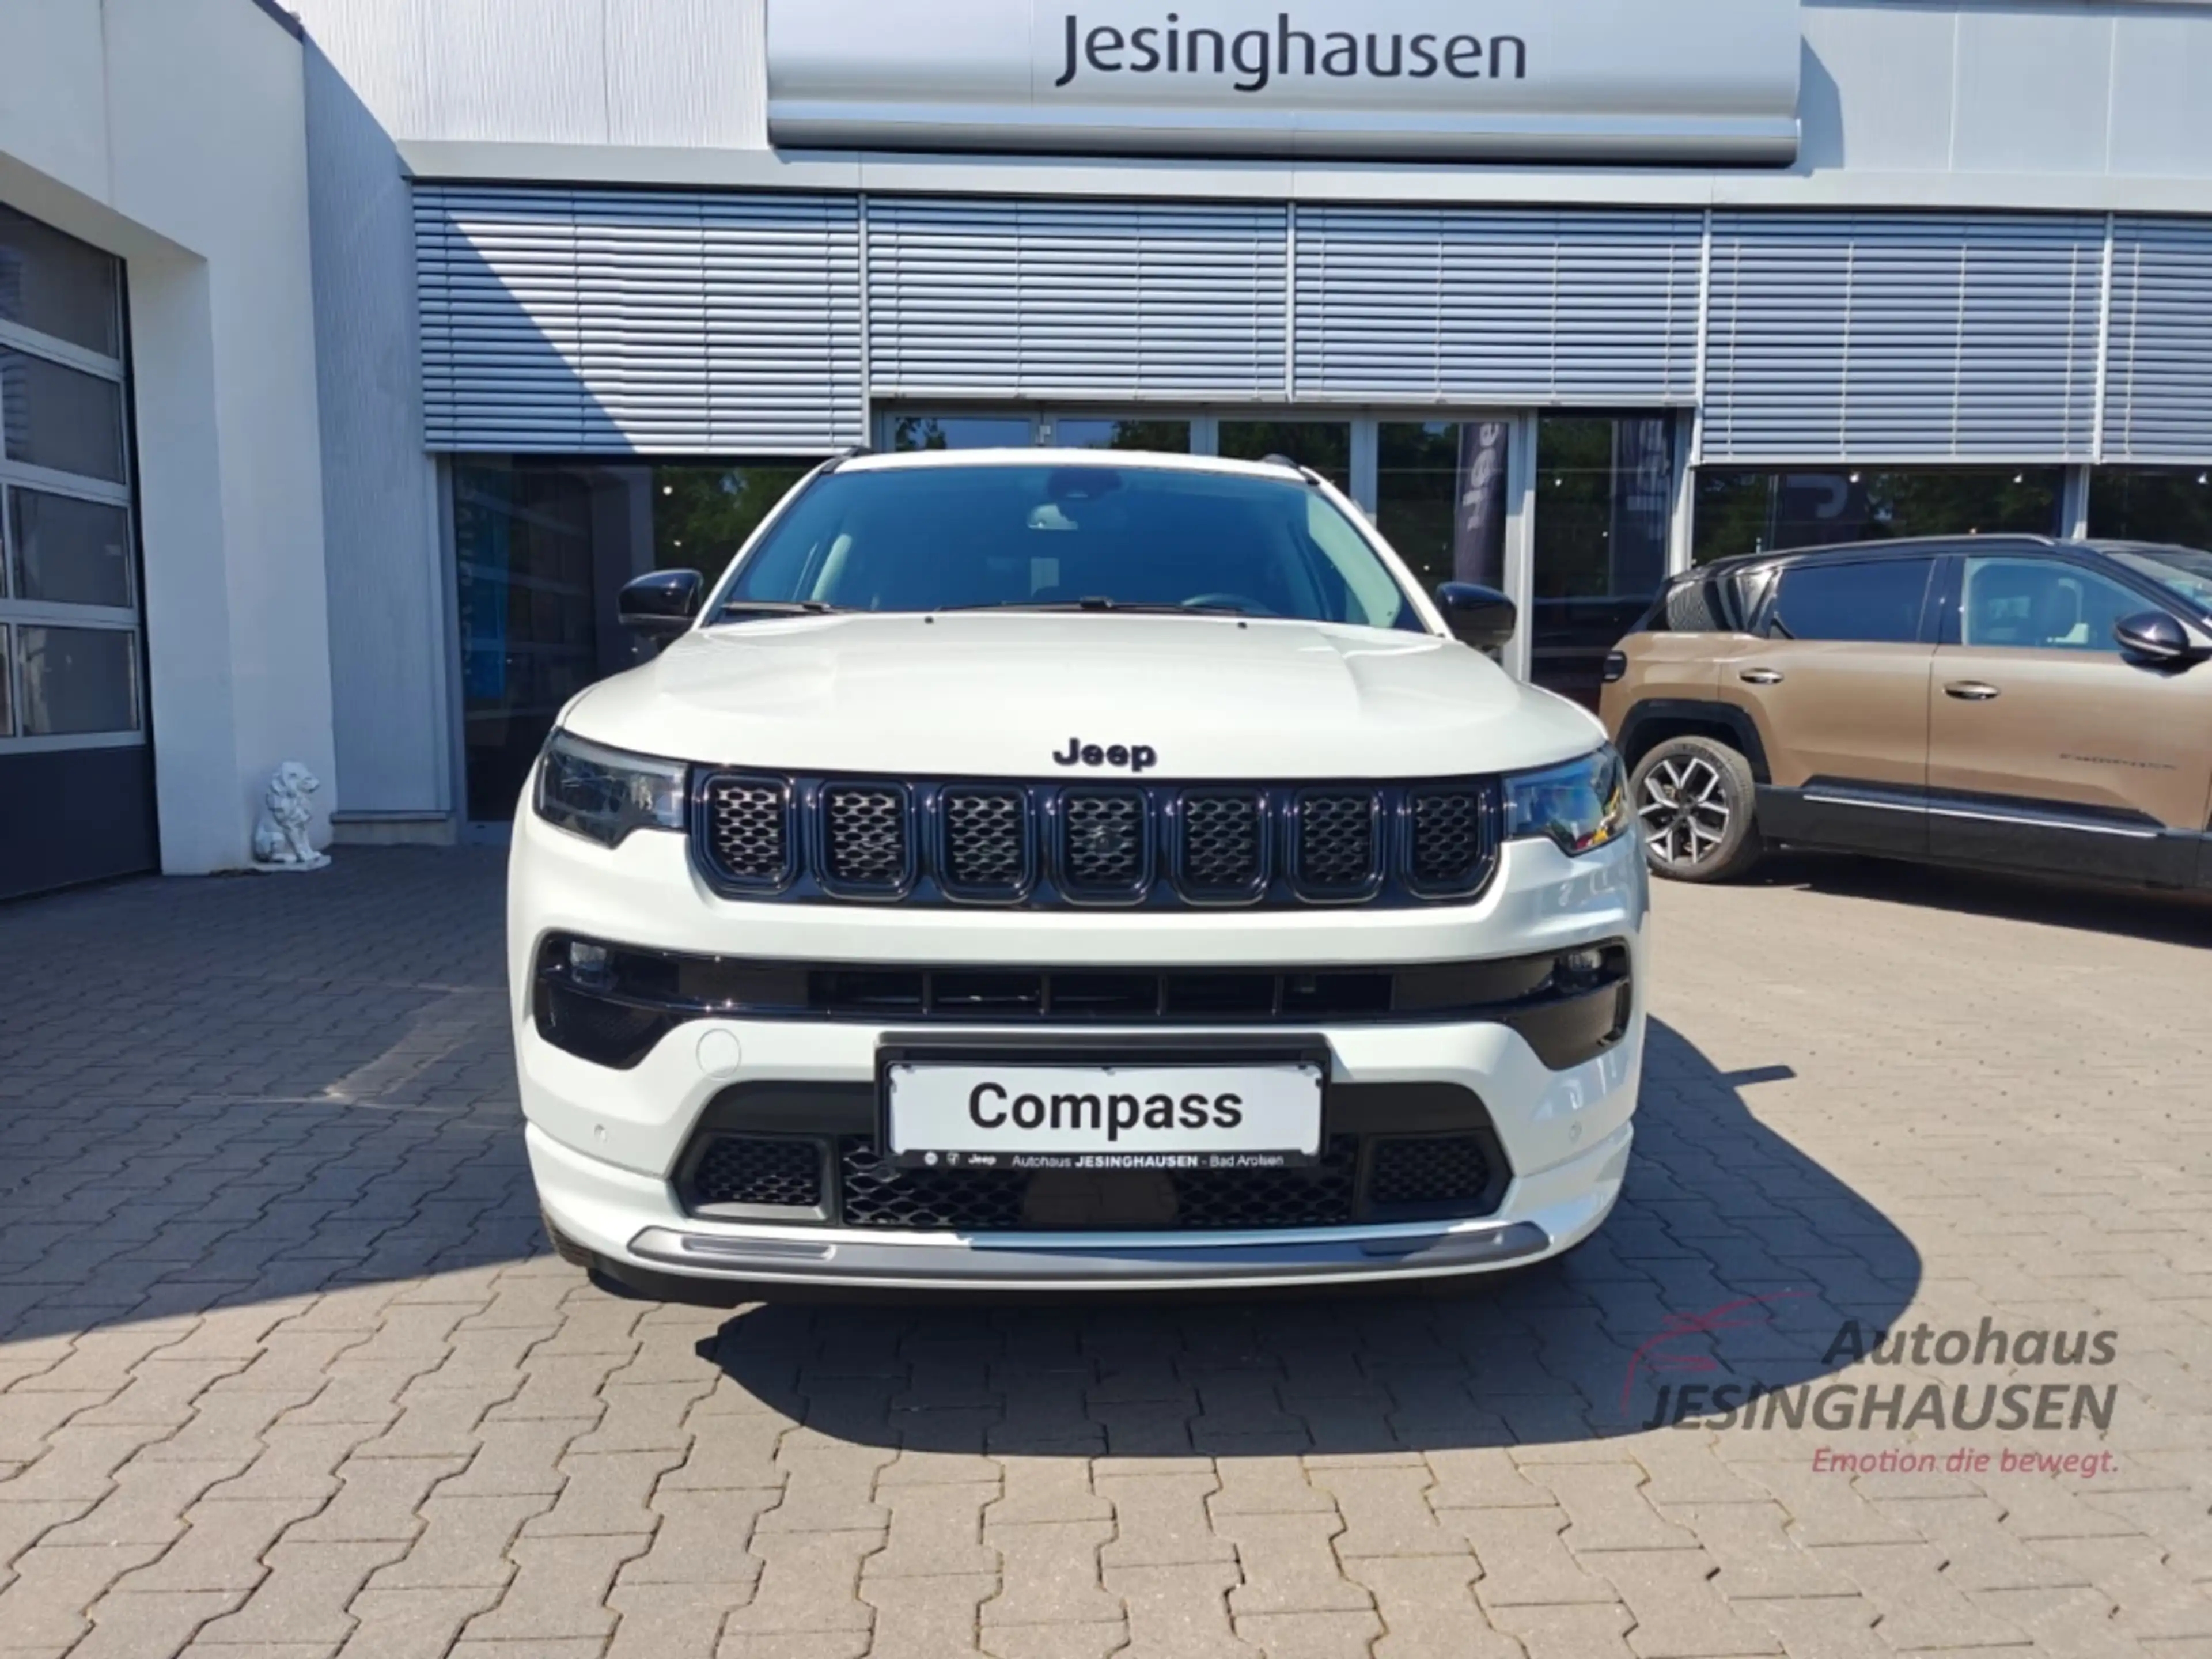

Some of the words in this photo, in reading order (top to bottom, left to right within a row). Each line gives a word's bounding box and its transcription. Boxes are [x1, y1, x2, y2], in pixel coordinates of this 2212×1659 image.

[1055, 13, 1525, 93] Jesinghausen
[1052, 738, 1157, 772] Jeep
[969, 1082, 1243, 1142] Compass
[968, 1154, 997, 1166] Jeep
[1012, 1155, 1072, 1168] Autohaus
[1074, 1155, 1198, 1168] JESINGHAUSEN
[1210, 1155, 1235, 1168] Bad
